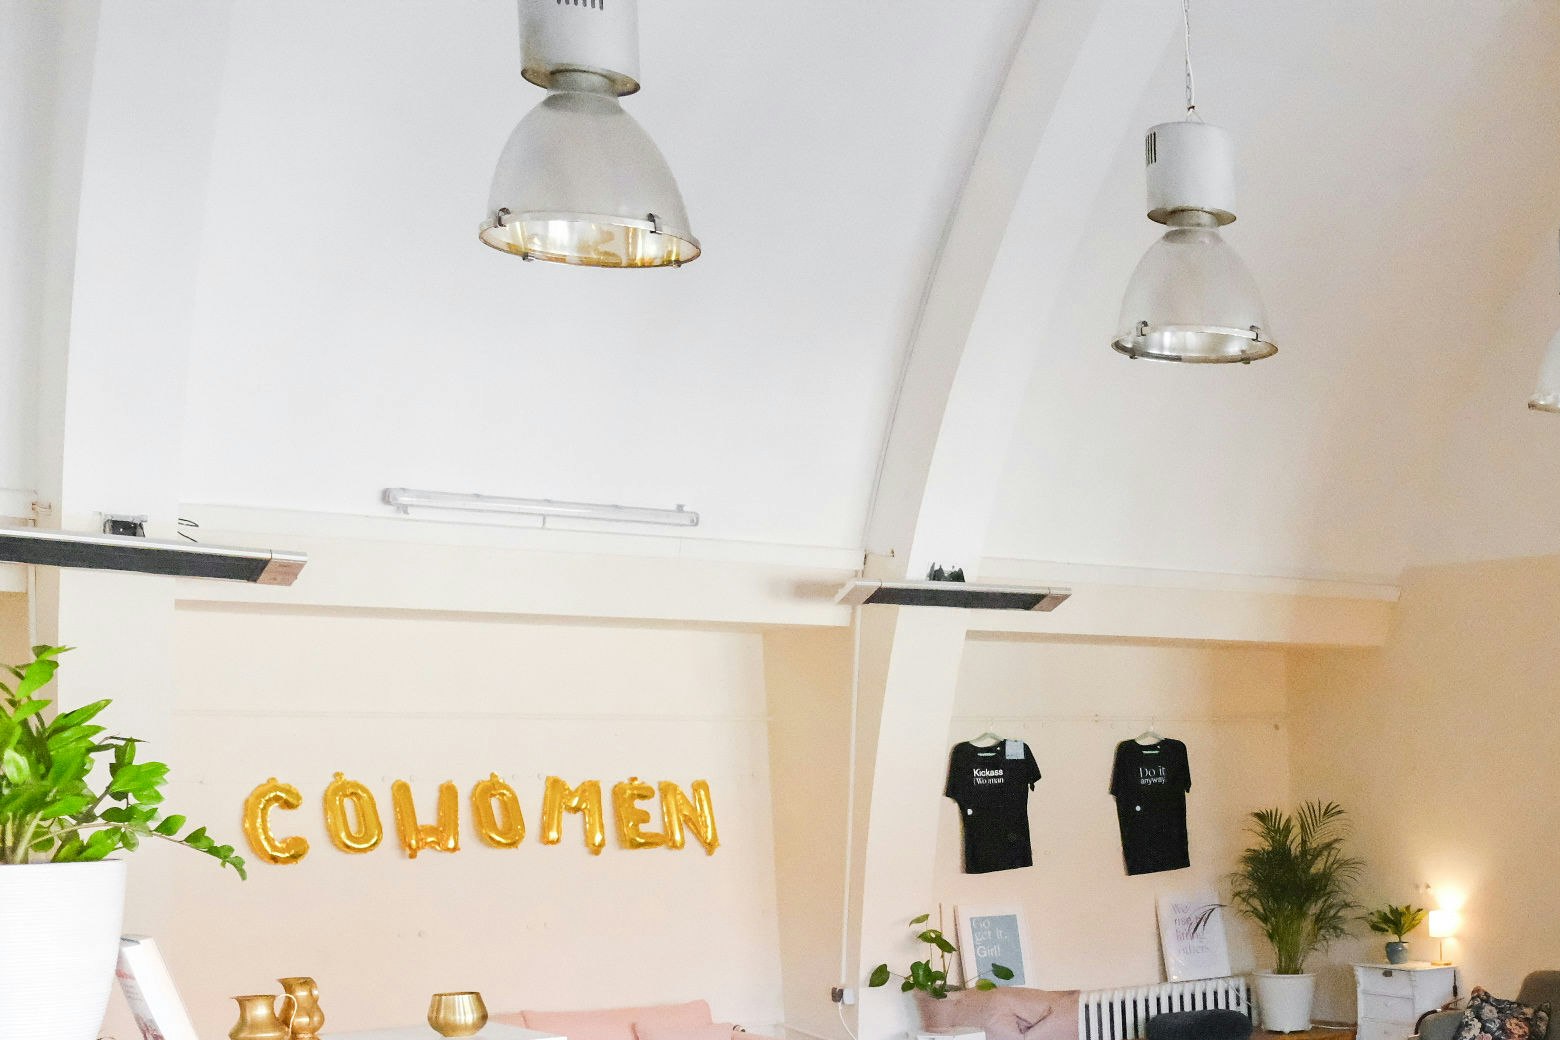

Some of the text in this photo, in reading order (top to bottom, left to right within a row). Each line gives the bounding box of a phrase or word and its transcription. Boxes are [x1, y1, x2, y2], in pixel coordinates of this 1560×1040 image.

[972, 768, 1004, 777] Kickass
[1139, 765, 1166, 778] Do it
[242, 770, 721, 865] COWOMEN
[973, 919, 991, 929] Go
[976, 945, 1001, 958] Girl!
